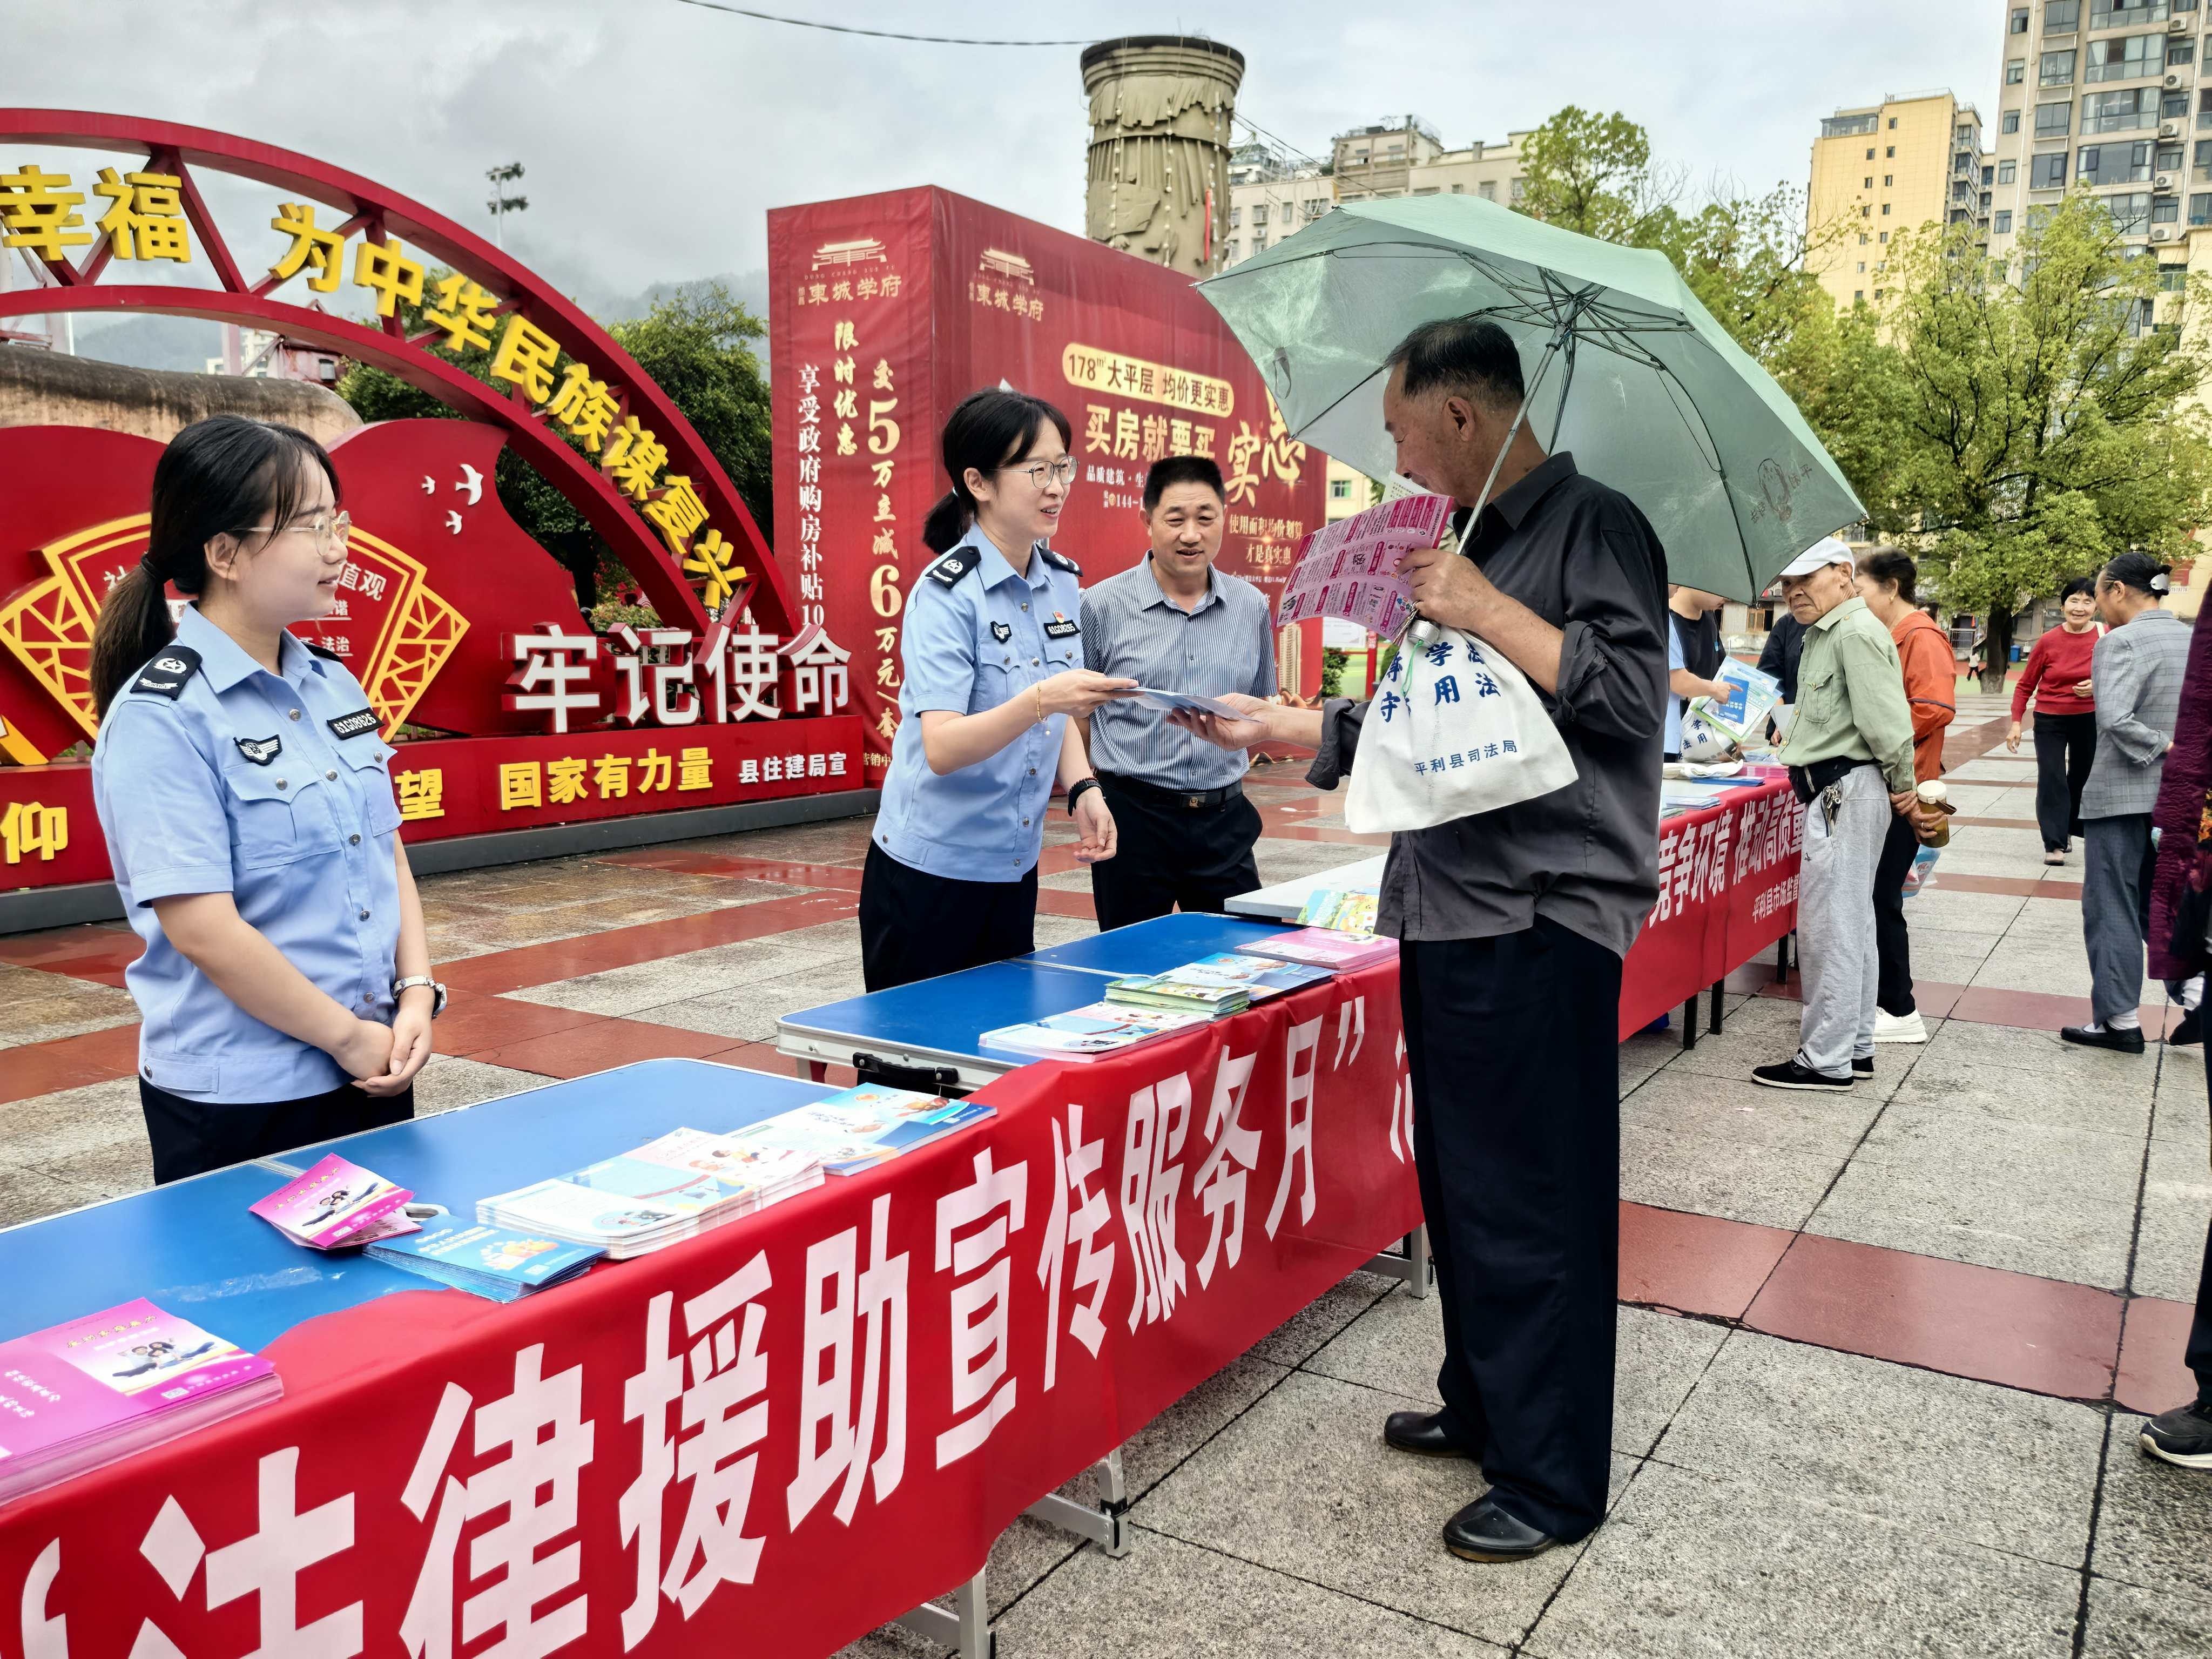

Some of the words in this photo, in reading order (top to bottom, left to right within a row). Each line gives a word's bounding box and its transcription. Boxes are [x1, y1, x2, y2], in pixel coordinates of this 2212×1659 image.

[0, 165, 191, 263] 幸福
[269, 202, 746, 609] 为中华民族谋复兴
[834, 320, 859, 456] 限时优惠
[1163, 371, 1229, 412] 均价更实惠
[1085, 404, 1215, 462] 买房就要买
[1229, 514, 1303, 540] 使用面积均价划算
[1246, 544, 1292, 564] 才是真实惠
[510, 622, 852, 734] 牢记使命
[1380, 673, 1501, 723] 守用法
[332, 713, 377, 735] 61G08626
[395, 769, 445, 821] 望
[500, 747, 713, 811] 国家有力量
[739, 752, 847, 783] 县住建局宣
[1414, 740, 1517, 776] 平利县司法局
[0, 801, 68, 864] 仰
[1649, 810, 1733, 928] 竞争环境
[1733, 790, 1806, 886] 推动高质量
